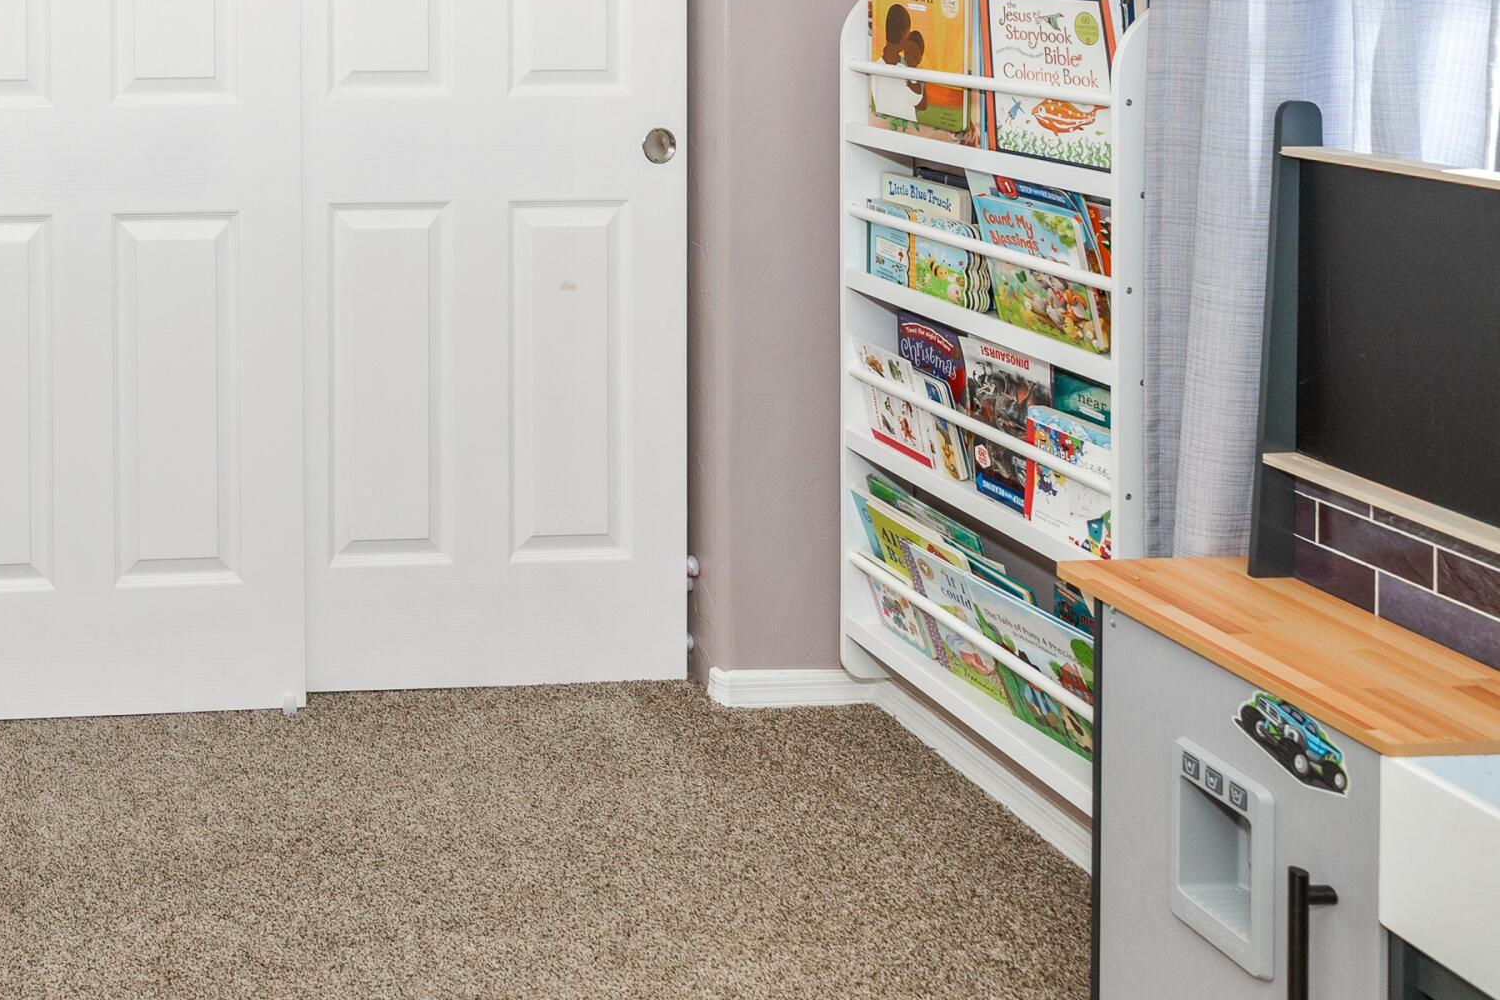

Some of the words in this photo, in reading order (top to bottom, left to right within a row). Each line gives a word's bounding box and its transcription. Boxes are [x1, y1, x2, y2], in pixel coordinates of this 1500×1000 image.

[999, 6, 1032, 26] Jesus
[1007, 0, 1017, 8] the
[1005, 24, 1072, 49] Storybook
[1044, 46, 1080, 67] Bible
[1003, 62, 1061, 87] Coloring
[1063, 68, 1099, 89] Book
[888, 181, 909, 196] Little
[909, 184, 927, 200] Blue
[927, 189, 952, 212] Truck
[1004, 181, 1012, 193] 1
[983, 208, 1014, 228] Count
[1015, 214, 1034, 240] My
[989, 229, 1039, 256] Blessings
[900, 337, 957, 380] Christmas
[981, 344, 1030, 371] DINOSAURS!
[1077, 393, 1107, 411] near
[944, 573, 956, 589] If
[940, 586, 973, 611] could
